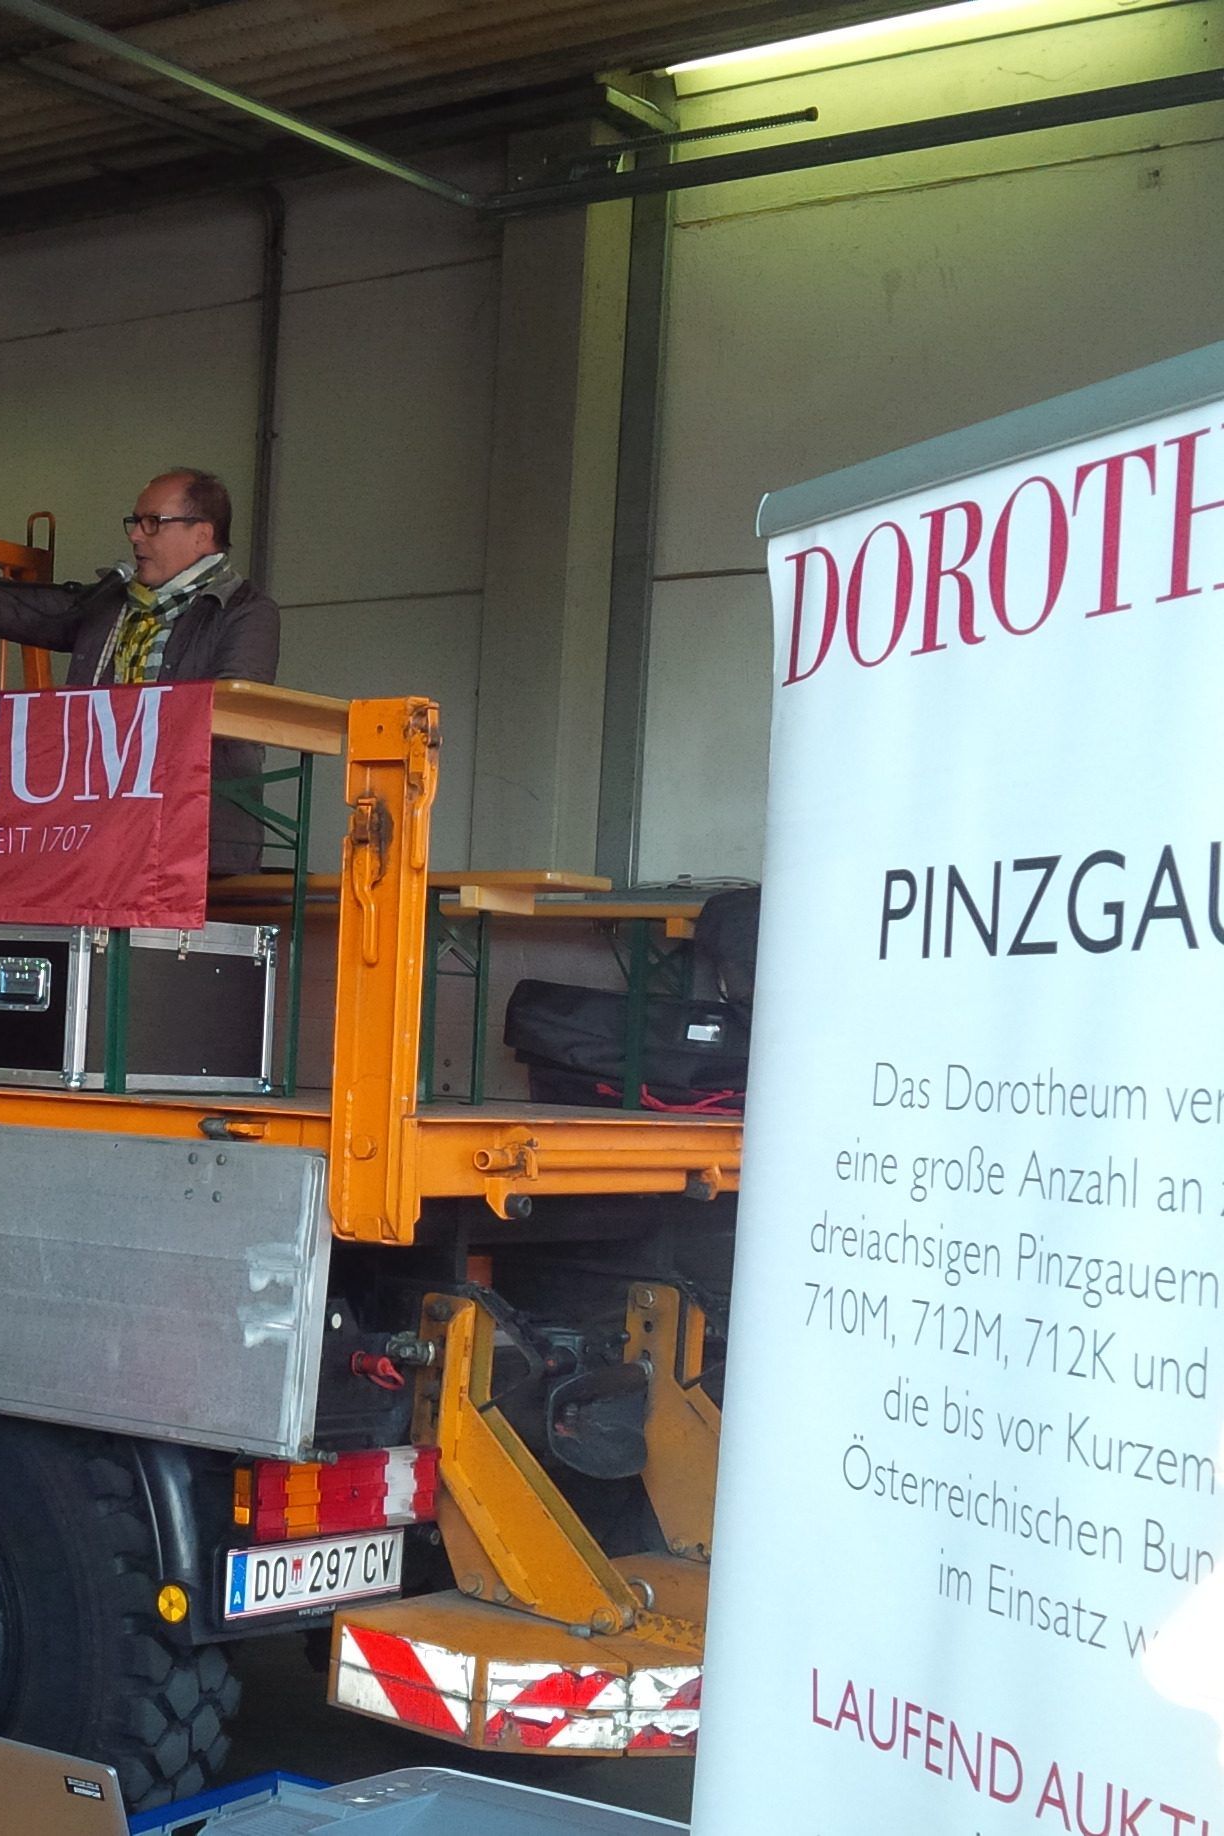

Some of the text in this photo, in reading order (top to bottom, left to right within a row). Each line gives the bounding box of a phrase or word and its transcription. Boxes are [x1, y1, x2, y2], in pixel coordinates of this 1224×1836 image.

[39, 824, 92, 852] 1707
[872, 1062, 931, 1110] Das
[945, 1064, 1147, 1121] Dorotheum
[836, 1137, 898, 1186] eine
[910, 1145, 1005, 1202] große
[1018, 1150, 1138, 1209] Anzahl
[1157, 1176, 1203, 1214] an
[810, 1210, 1219, 1309] dreiachsigen Pinzgauern
[804, 1282, 1208, 1400] 710M, 712M, 712K und
[883, 1376, 1215, 1495] die bis vor Kurzem
[842, 1433, 1122, 1563] Österreichischen
[233, 1539, 395, 1604] A DO 297 CV
[938, 1547, 972, 1605] im
[988, 1563, 1107, 1649] Einsatz
[812, 1667, 1024, 1804] LAUFEND
